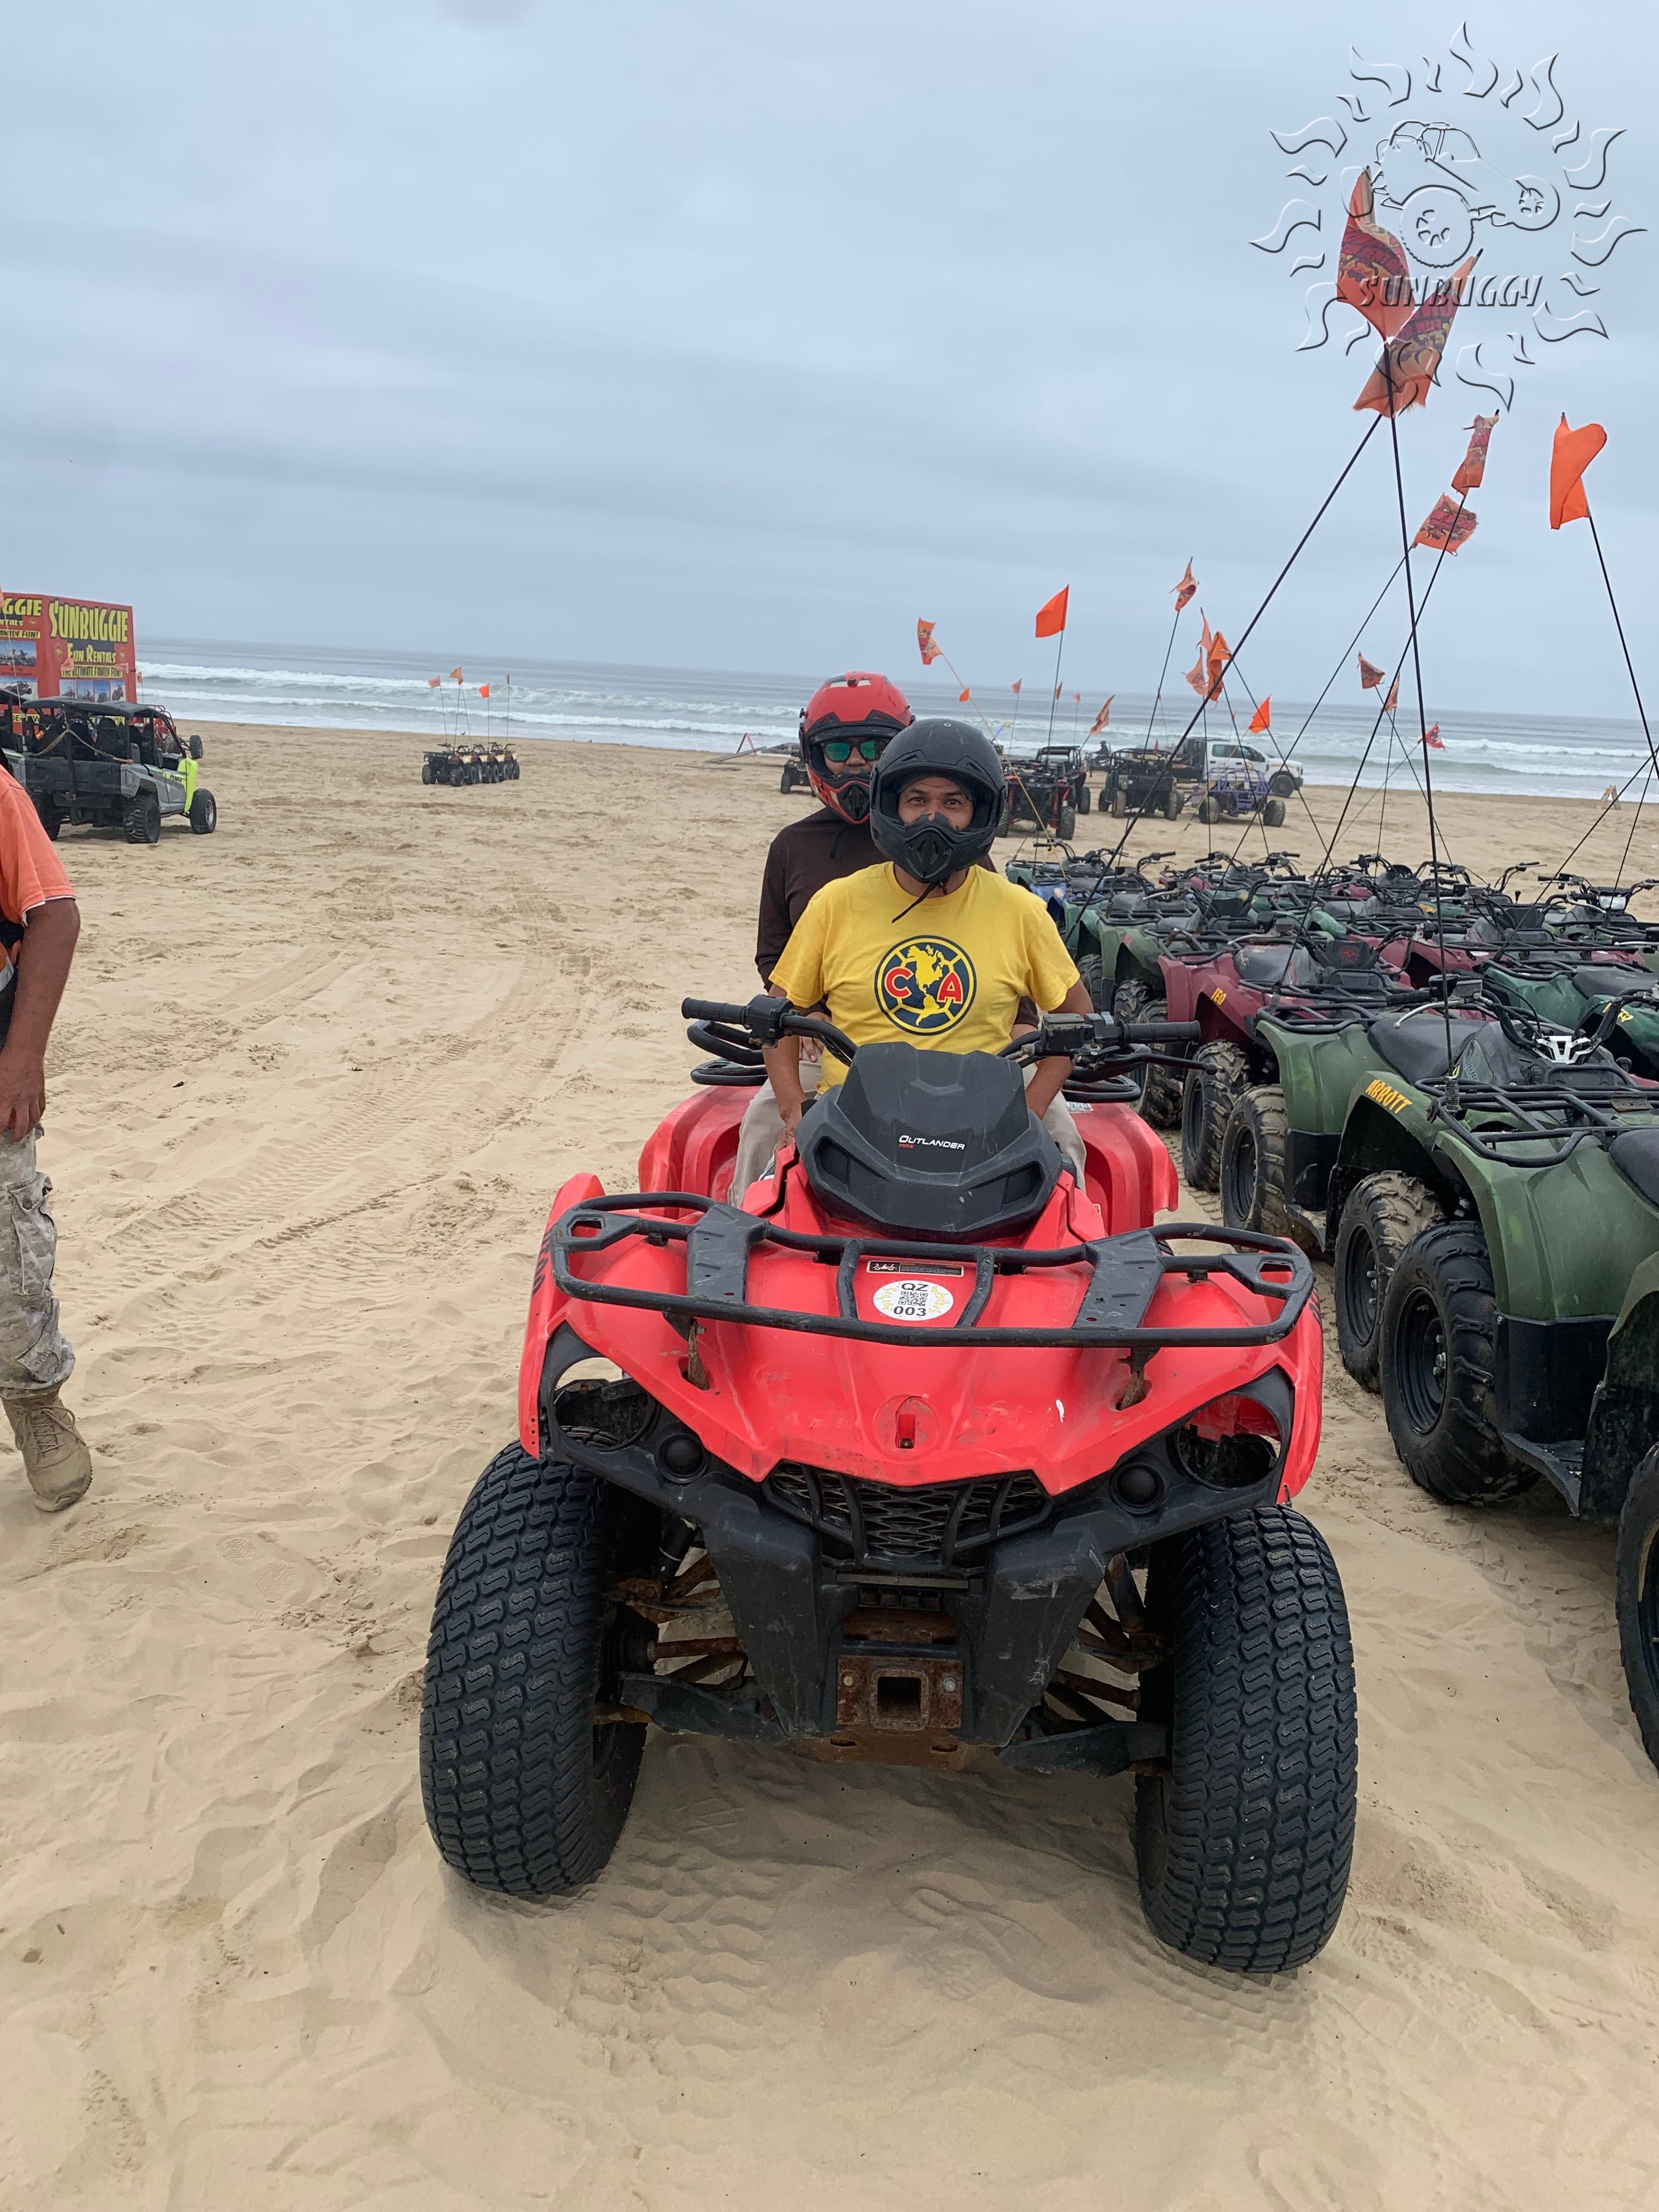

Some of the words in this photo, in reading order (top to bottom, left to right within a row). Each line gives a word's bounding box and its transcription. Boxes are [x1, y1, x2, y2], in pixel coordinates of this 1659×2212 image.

[2, 597, 42, 616] GGIE
[49, 600, 128, 642] SUNBUGGIE
[884, 966, 914, 999] C
[936, 971, 963, 1004] A
[1365, 1079, 1413, 1114] ABBOTT
[899, 1135, 966, 1150] OUTLANDER
[901, 1283, 929, 1292] QZ
[893, 1306, 927, 1317] 003
